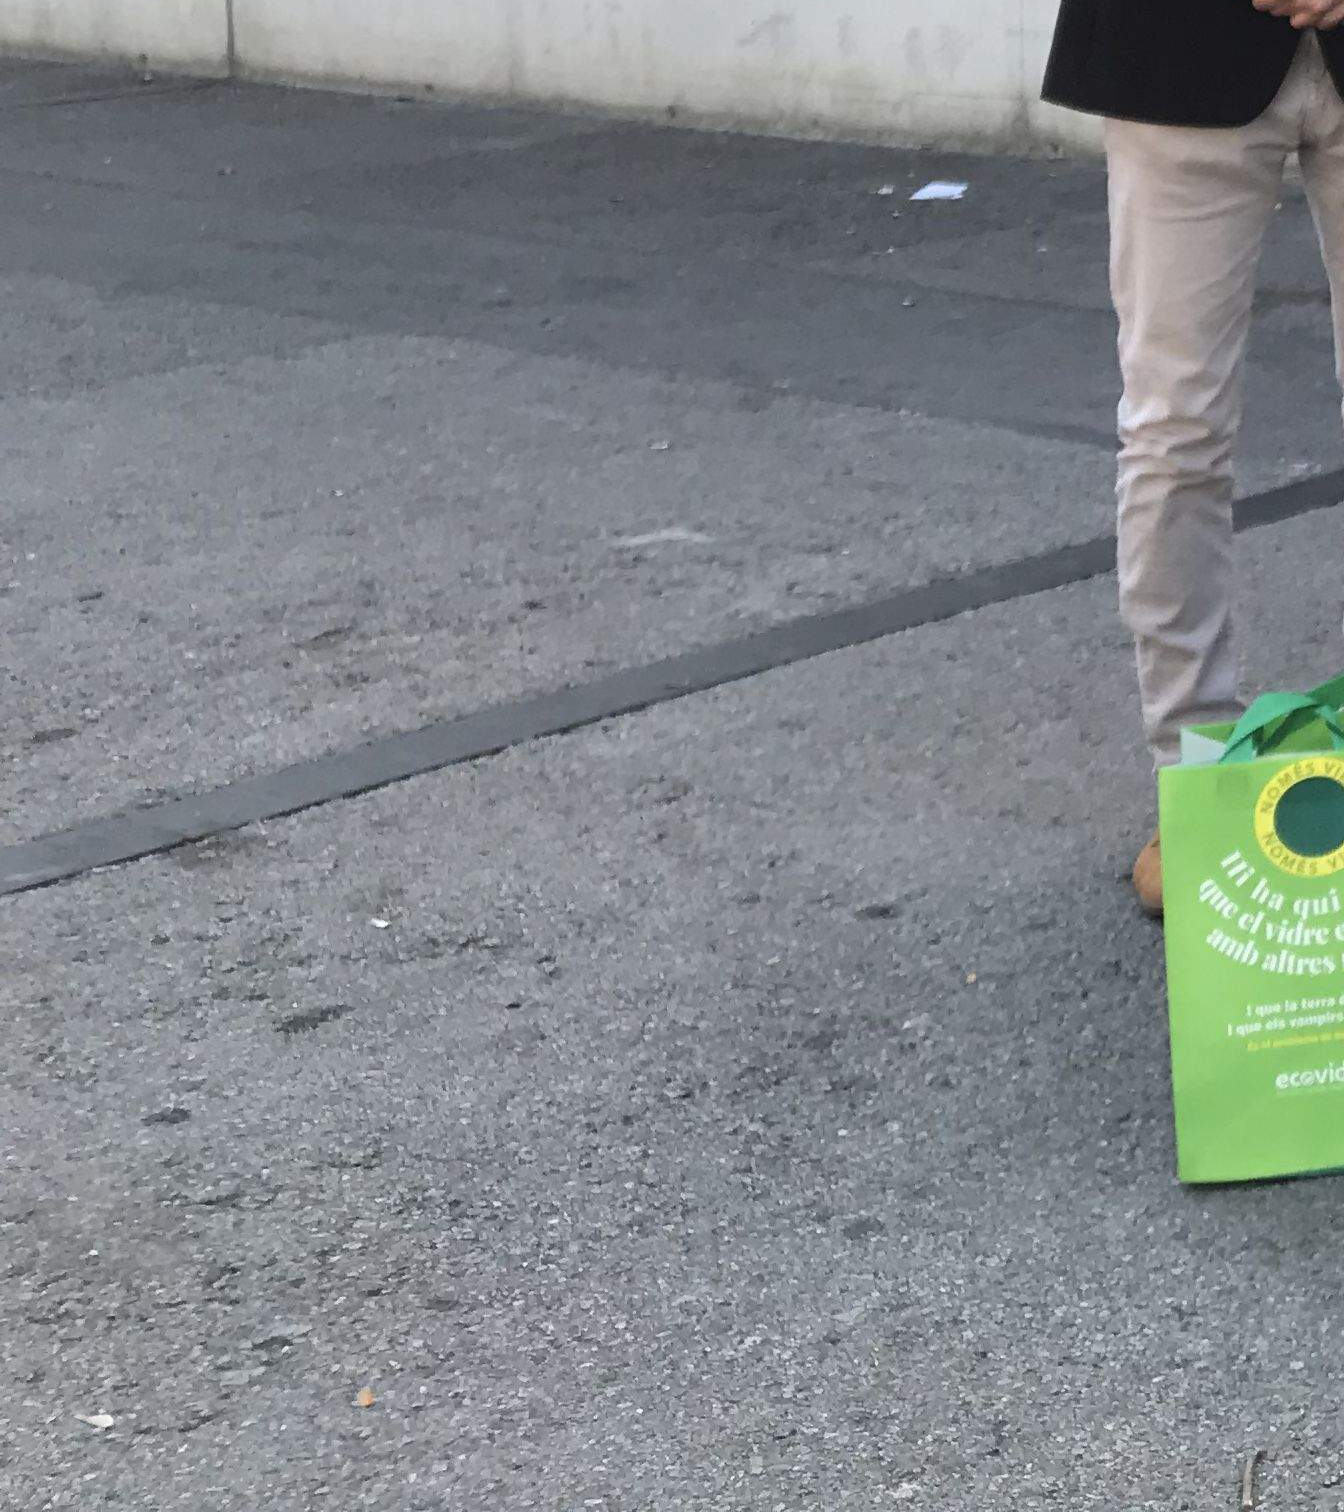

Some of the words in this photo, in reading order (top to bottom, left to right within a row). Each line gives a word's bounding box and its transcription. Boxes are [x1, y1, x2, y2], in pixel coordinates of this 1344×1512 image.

[1200, 878, 1238, 919] que
[1238, 912, 1265, 934] el
[1266, 919, 1329, 945] vidre
[1251, 878, 1284, 911] ha
[1293, 888, 1341, 919] qui
[1206, 929, 1258, 966] amb
[1262, 949, 1336, 976] altres
[1236, 1022, 1262, 1036] que
[1289, 1012, 1344, 1027] vampirs
[1255, 1004, 1280, 1017] que
[1285, 1000, 1296, 1012] la
[1300, 998, 1335, 1010] terra
